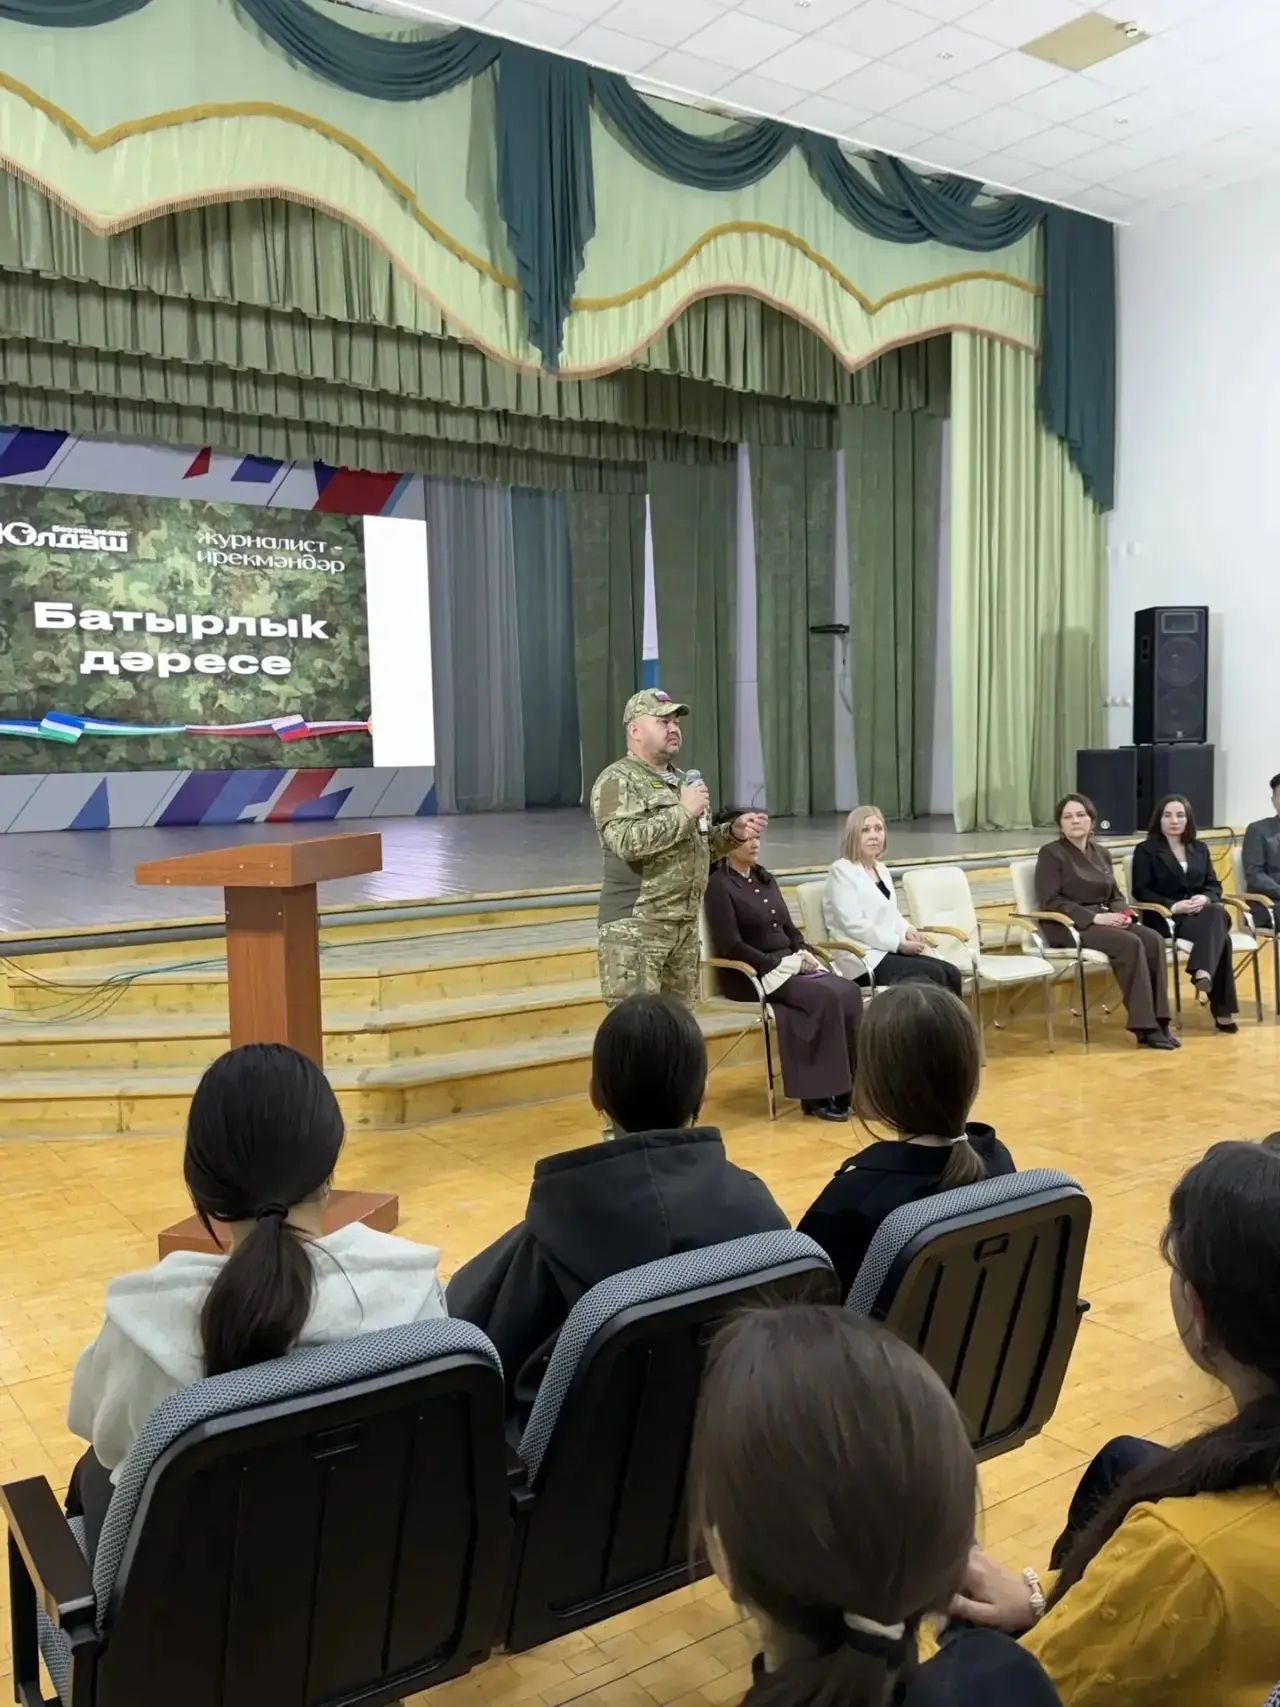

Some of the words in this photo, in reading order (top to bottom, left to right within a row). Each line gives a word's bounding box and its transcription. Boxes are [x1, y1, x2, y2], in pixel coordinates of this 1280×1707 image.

[0, 522, 128, 552] Юлдаш
[197, 532, 327, 553] журналист
[80, 650, 292, 678] дәресе
